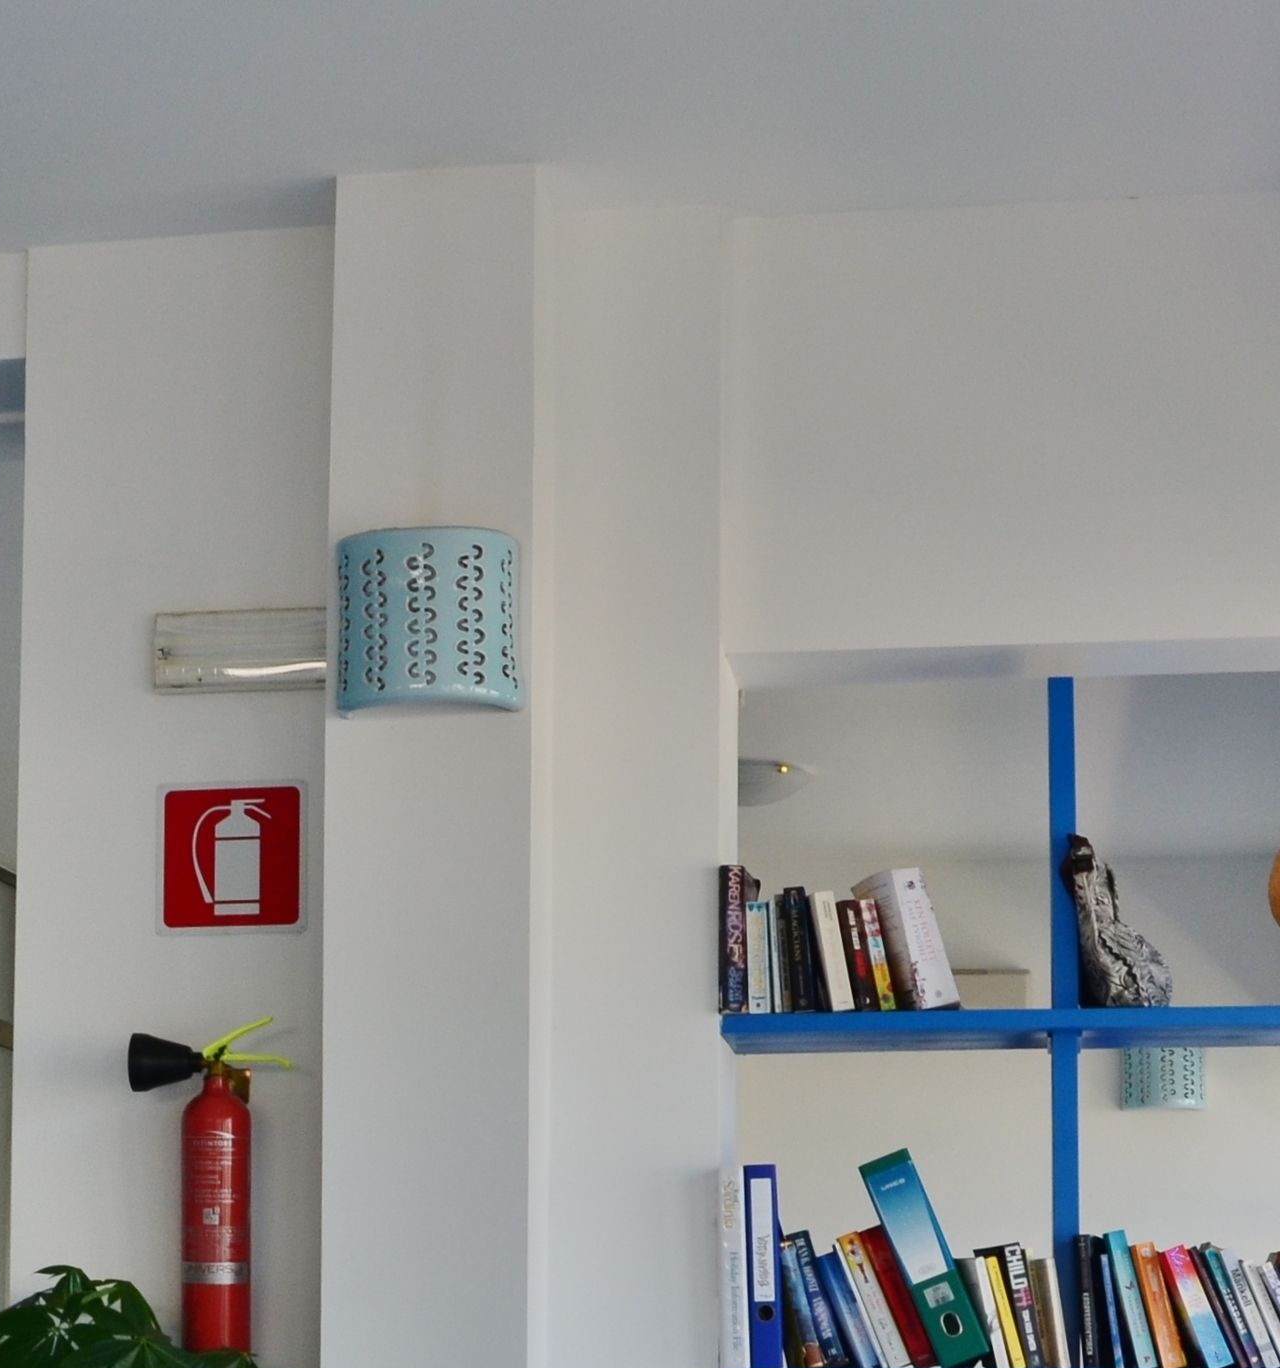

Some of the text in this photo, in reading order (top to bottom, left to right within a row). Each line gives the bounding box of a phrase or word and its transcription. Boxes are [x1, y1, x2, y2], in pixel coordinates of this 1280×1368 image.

[728, 866, 742, 910] KAREN
[1004, 1245, 1028, 1290] CHILD
[1231, 1268, 1252, 1308] Mankell
